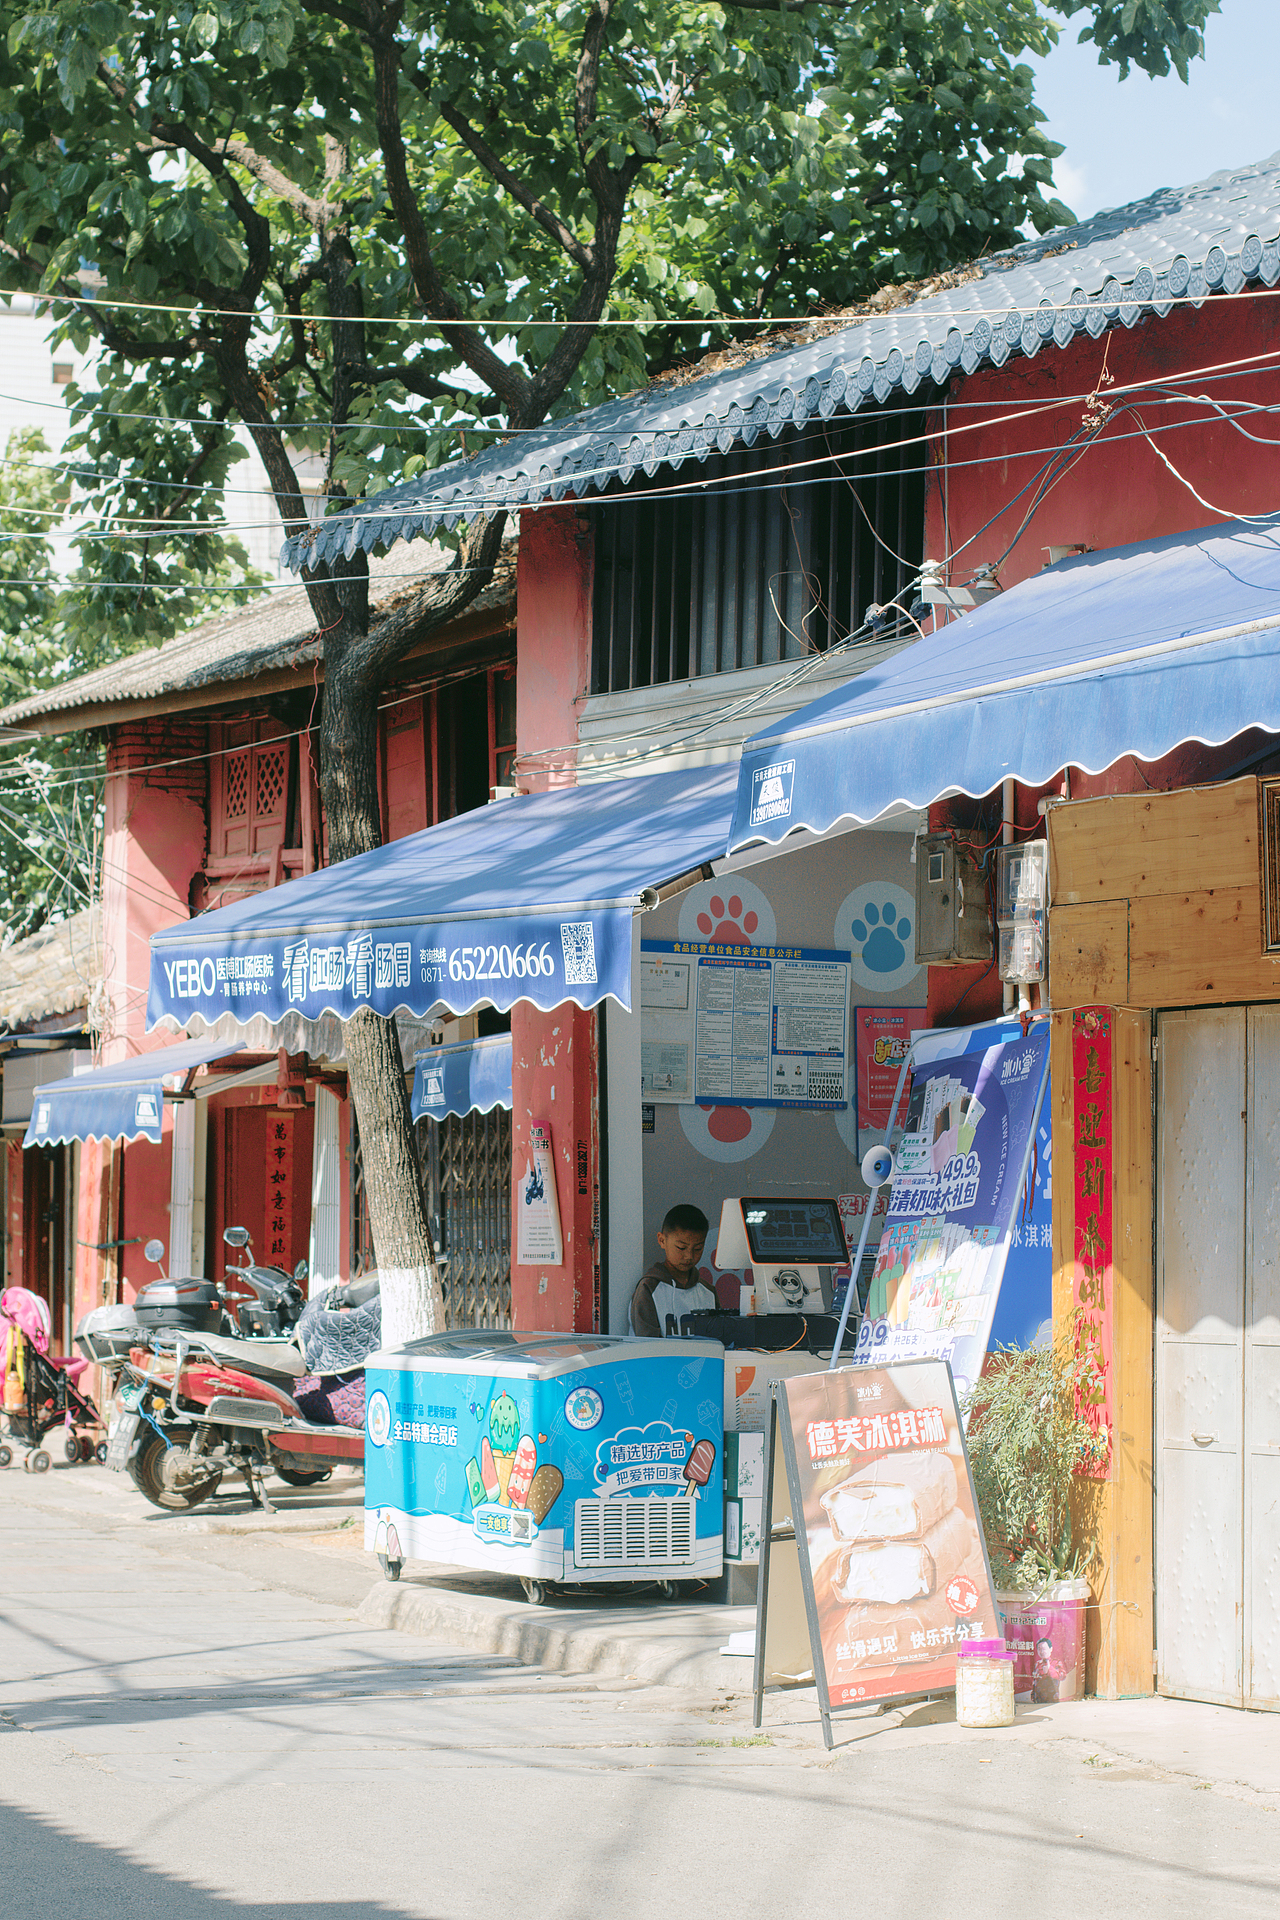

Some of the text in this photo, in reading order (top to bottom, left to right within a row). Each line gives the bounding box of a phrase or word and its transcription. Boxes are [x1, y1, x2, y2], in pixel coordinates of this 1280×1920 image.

[420, 947, 447, 964] 咨询热线
[449, 942, 554, 981] 65220666
[673, 942, 802, 959] 食品经营单位食品安全信息公示栏
[163, 957, 216, 998] YEBO
[216, 954, 274, 980] 医博肛肠医院
[282, 933, 411, 1002] 看肛肠看肠胃
[421, 967, 447, 983] 0871-
[223, 980, 268, 997] 胃肠养护中心
[1001, 1049, 1036, 1079] 冰小盒
[808, 1084, 843, 1100] 63368660
[943, 1155, 976, 1182] 49.9
[990, 1163, 1005, 1206] CREAM
[393, 1420, 458, 1446] 全品特惠会员店
[806, 1408, 947, 1458] 德芙冰淇淋
[611, 1441, 685, 1462] 精选好产品
[616, 1466, 683, 1486] 把爱带回家
[836, 1621, 985, 1661] 丝滑遇见 快乐齐分享
